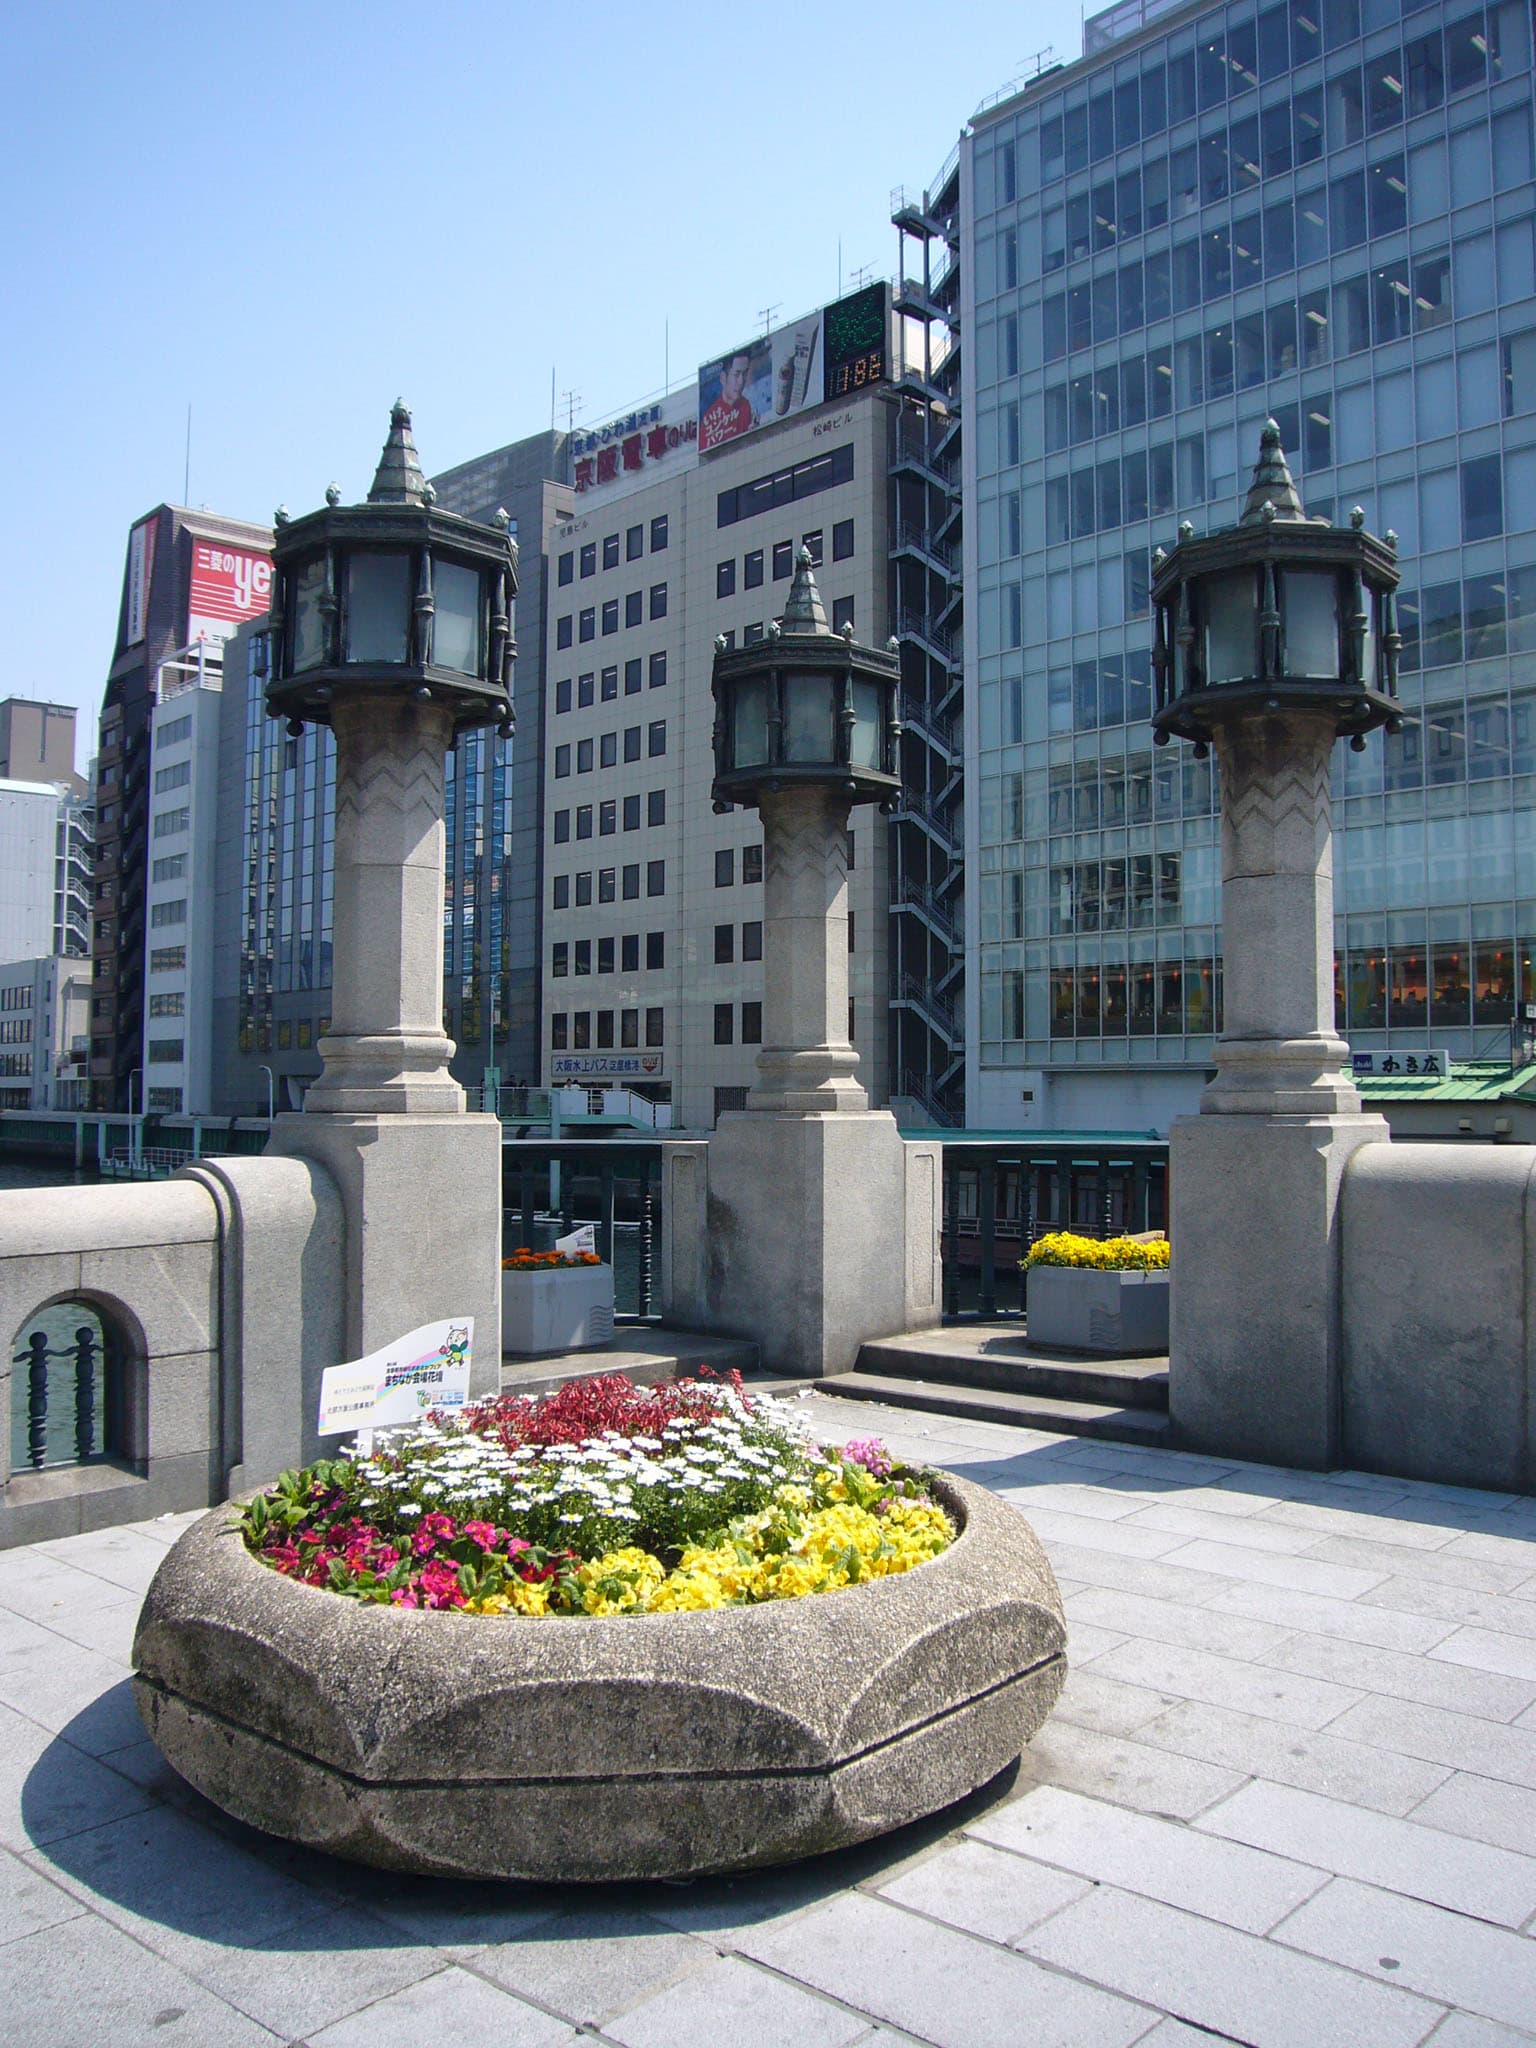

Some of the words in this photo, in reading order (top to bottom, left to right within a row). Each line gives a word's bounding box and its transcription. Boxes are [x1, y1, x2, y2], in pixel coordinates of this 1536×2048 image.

[197, 547, 235, 574] 三菱の
[555, 1058, 608, 1073] 大阪水上バス
[1381, 1054, 1440, 1074] かき広
